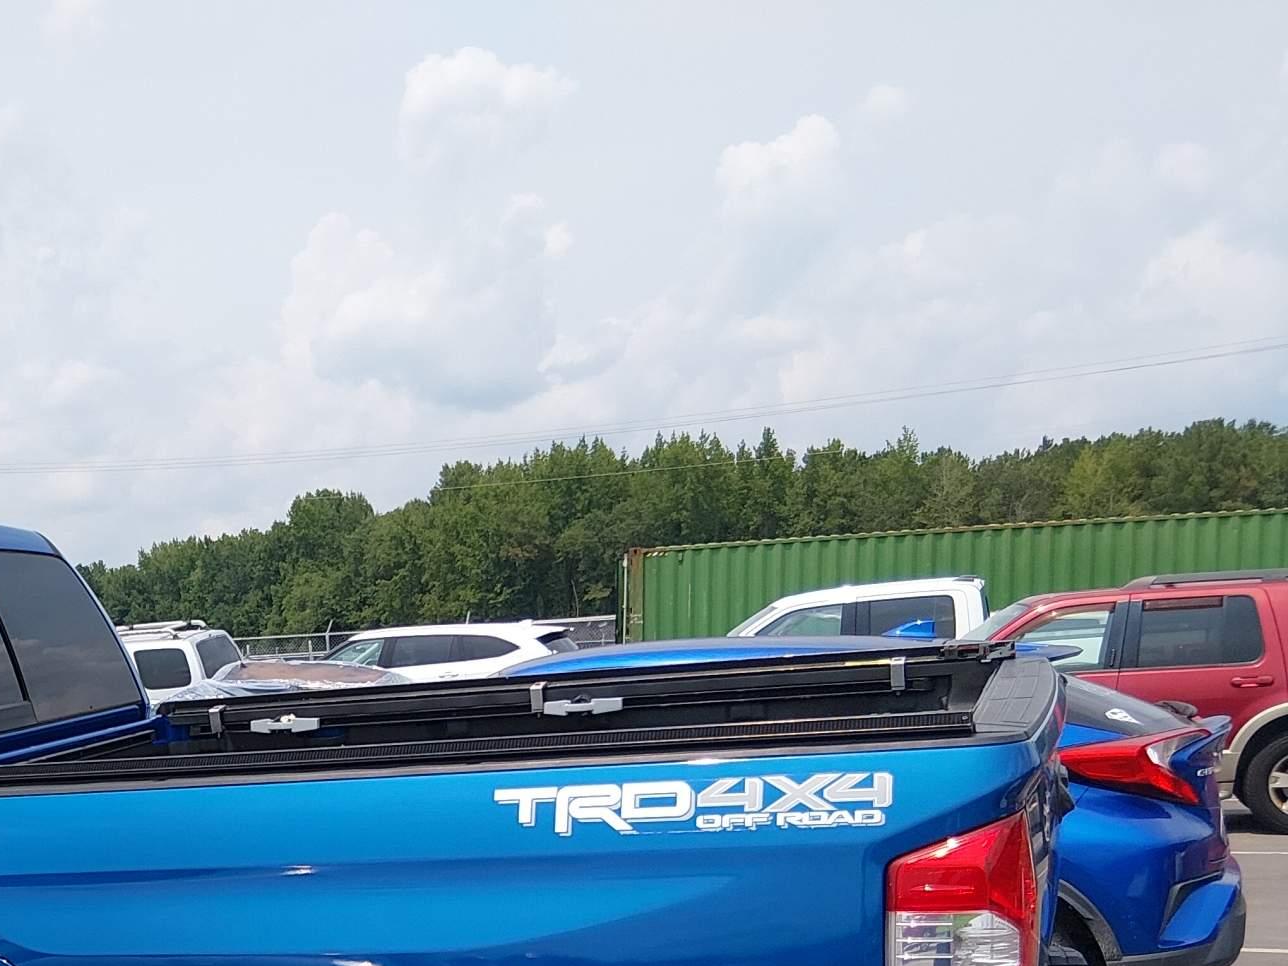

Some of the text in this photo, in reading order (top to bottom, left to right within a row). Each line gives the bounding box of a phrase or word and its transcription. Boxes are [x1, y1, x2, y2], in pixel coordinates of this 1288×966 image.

[493, 780, 695, 836] TRD
[695, 809, 886, 831] OFF ROAD
